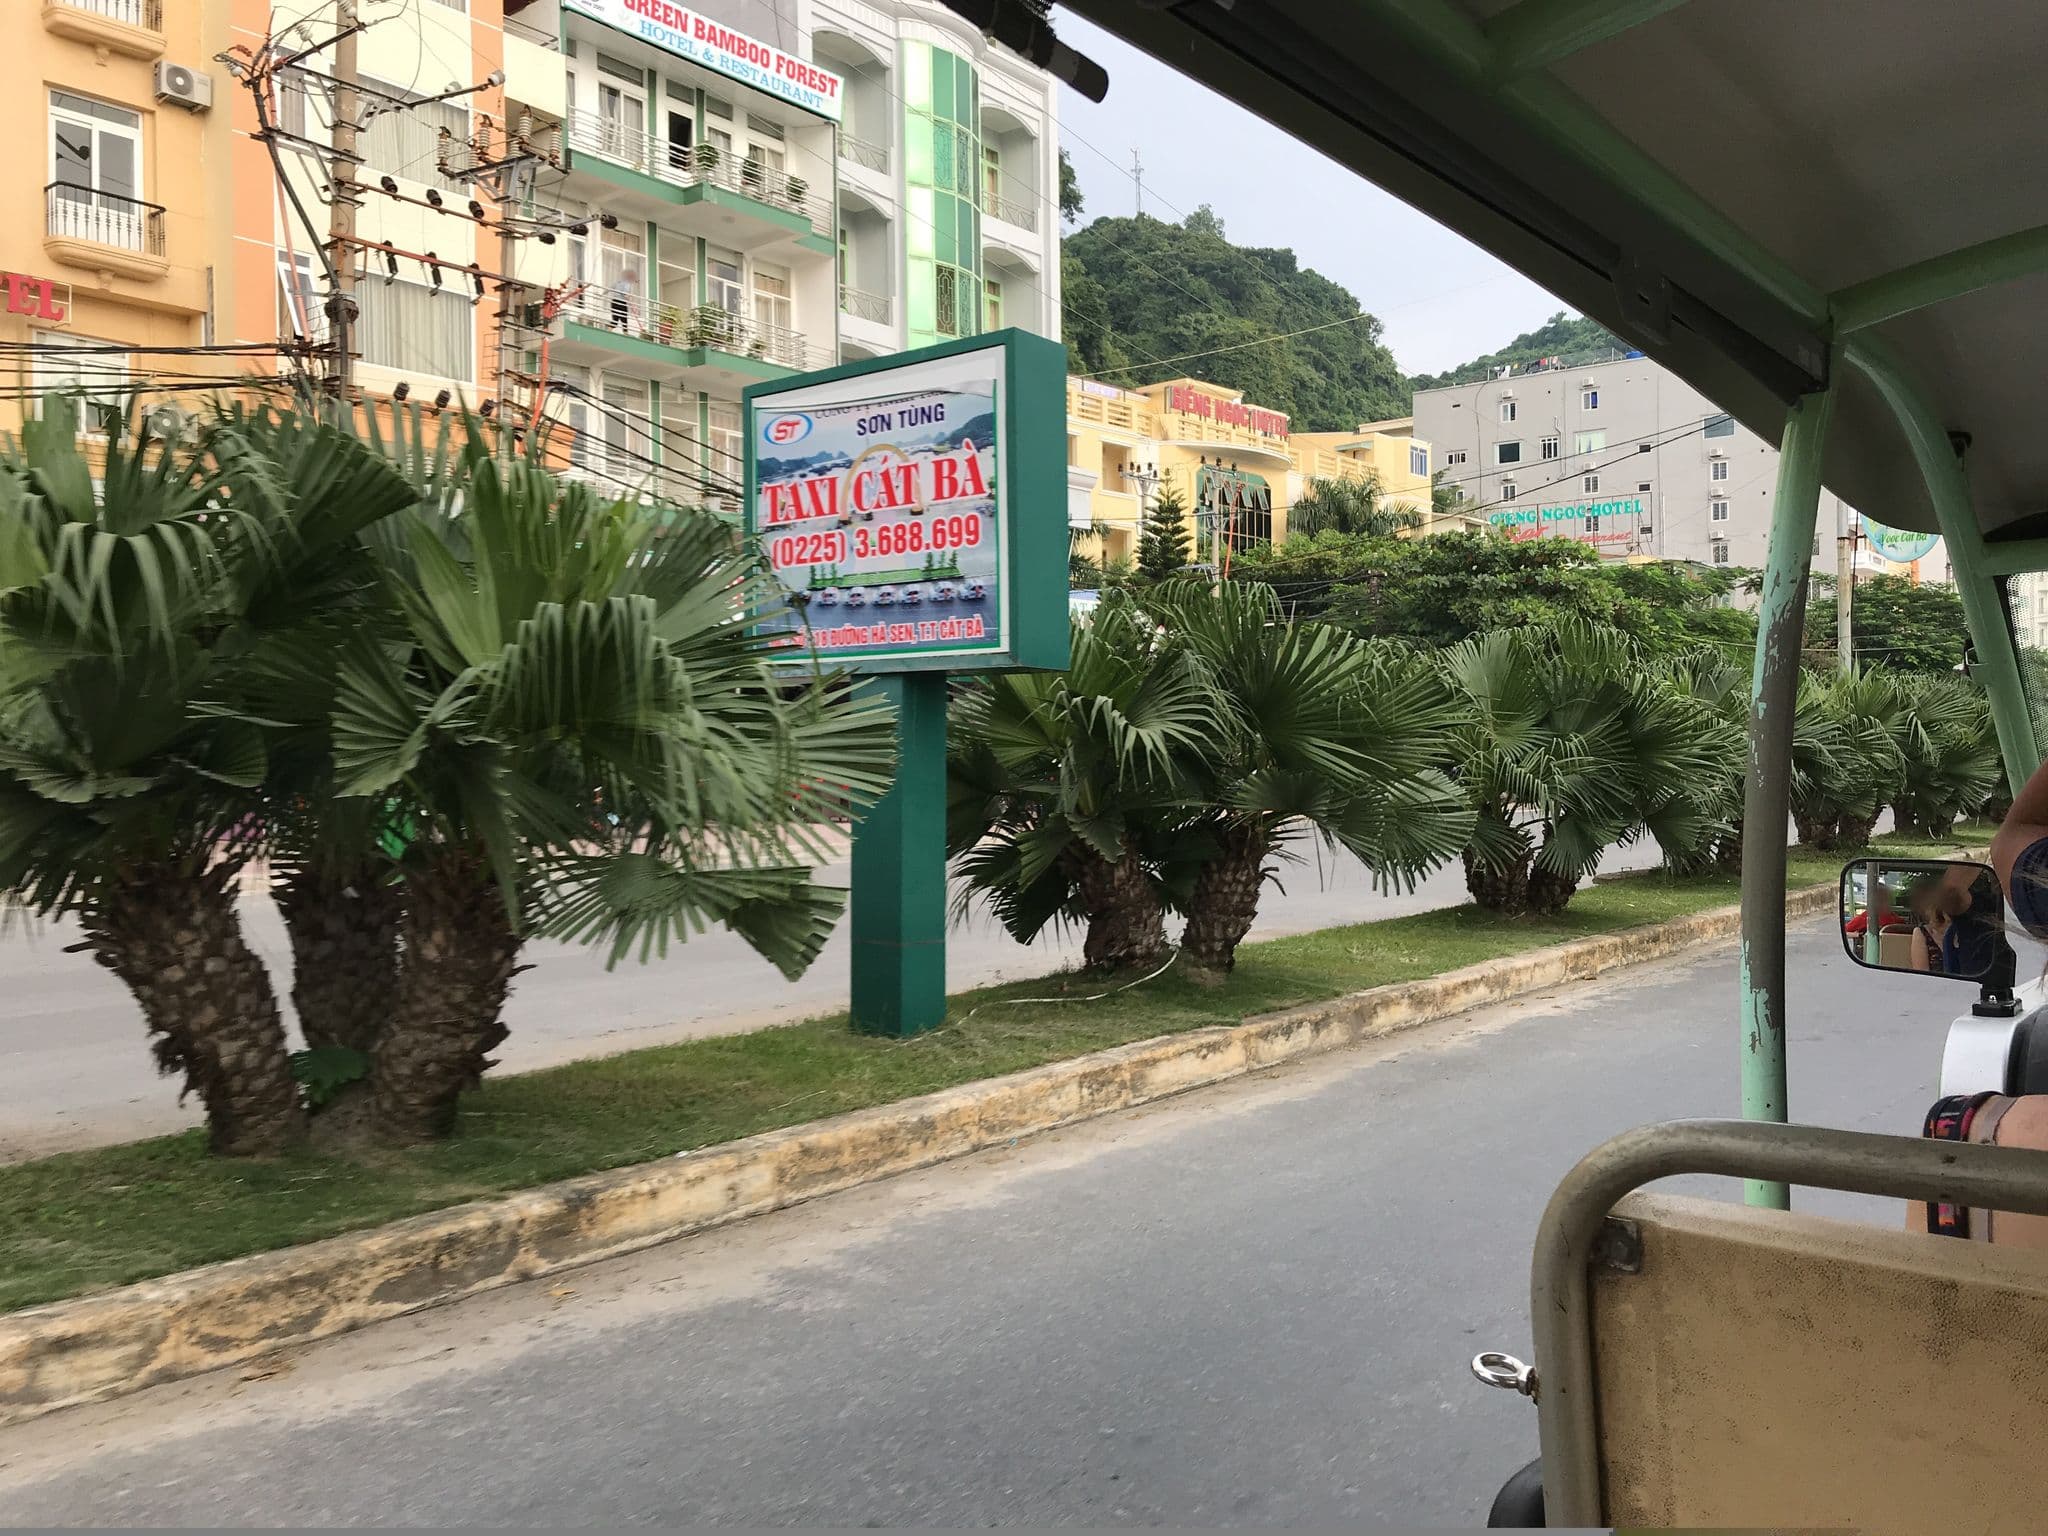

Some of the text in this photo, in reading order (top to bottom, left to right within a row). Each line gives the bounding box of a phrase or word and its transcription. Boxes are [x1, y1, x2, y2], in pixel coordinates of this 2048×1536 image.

[624, 0, 838, 97] GREEN BAMBOO FOREST
[639, 20, 824, 109] HOTEL & RESTAURANT
[773, 420, 801, 441] ST
[856, 403, 945, 437] SƠN TÙNG
[764, 441, 986, 524] TAXI CÁT BÀ
[1590, 499, 1644, 517] HOTEL
[772, 514, 980, 570] (0225) 3.688.699
